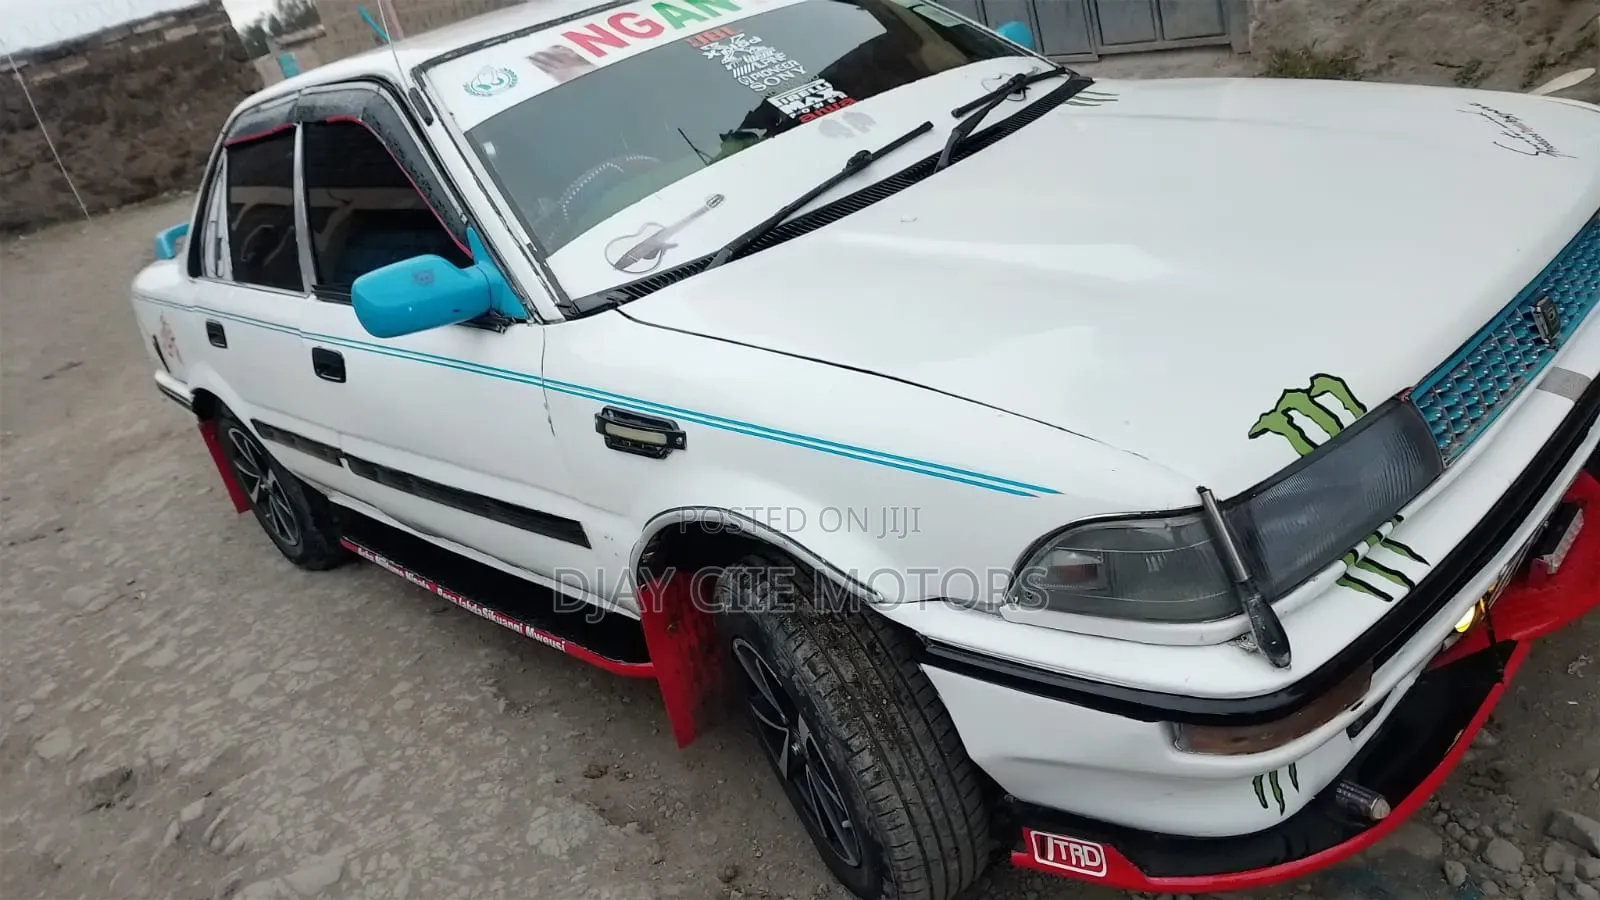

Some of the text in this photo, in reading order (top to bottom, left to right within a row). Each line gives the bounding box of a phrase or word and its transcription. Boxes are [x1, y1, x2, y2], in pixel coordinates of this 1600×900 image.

[749, 65, 807, 92] SONY
[778, 87, 840, 115] MAX
[1053, 839, 1101, 868] TRD
